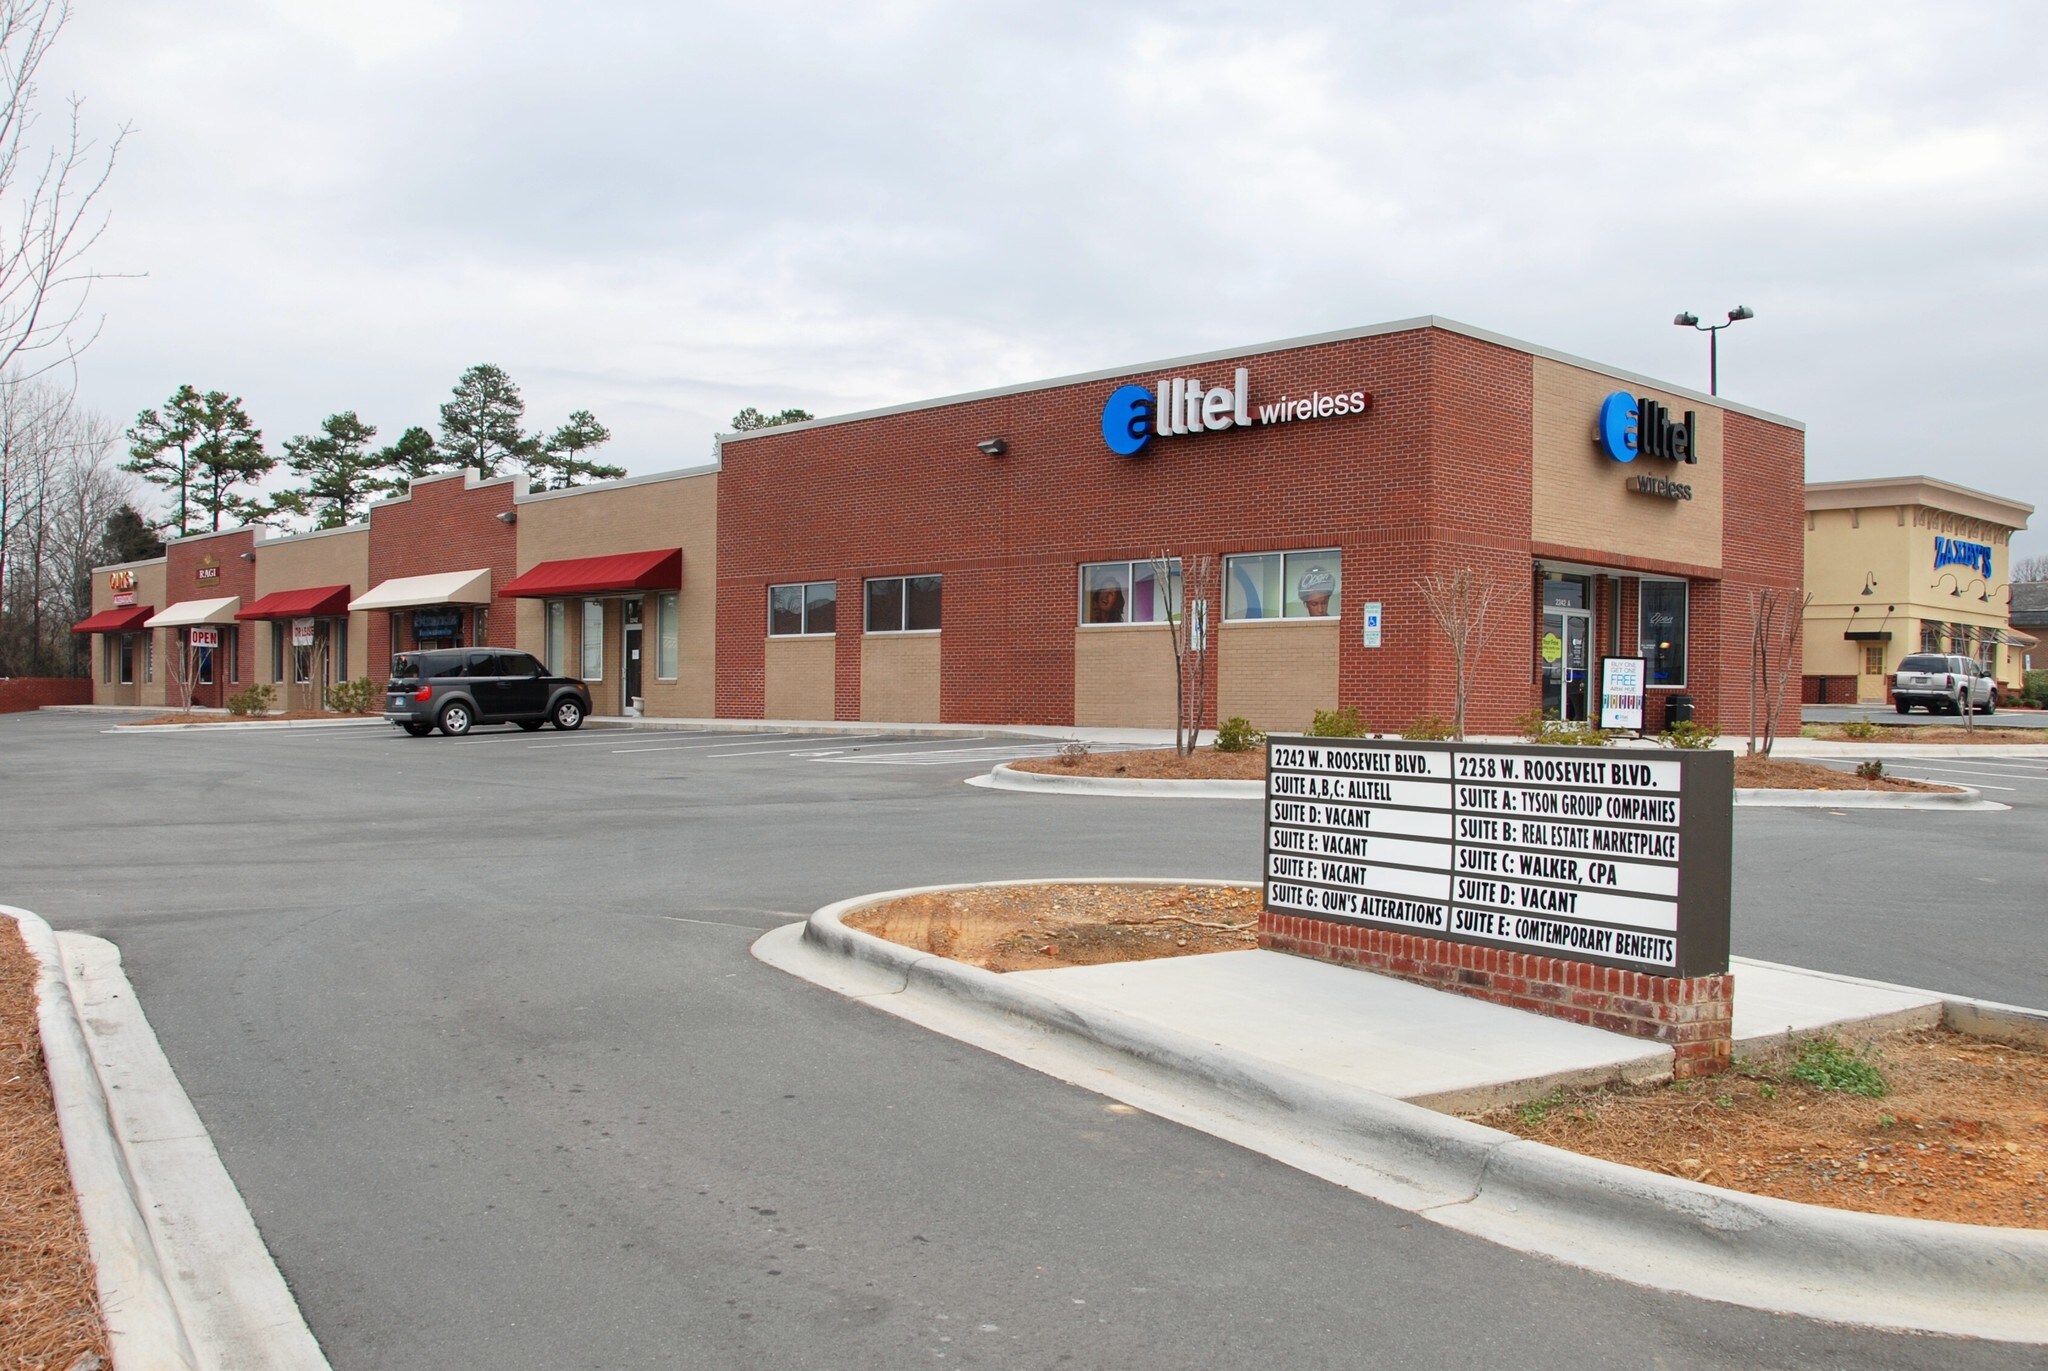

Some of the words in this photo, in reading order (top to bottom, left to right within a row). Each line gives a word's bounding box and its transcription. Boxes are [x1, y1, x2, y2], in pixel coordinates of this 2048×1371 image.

[1102, 367, 1252, 456] alltel
[1259, 391, 1365, 425] wireless
[1599, 391, 1697, 464] alltel
[1636, 471, 1693, 501] wireless
[199, 568, 216, 578] RAGI
[1934, 536, 1992, 579] ZAXBY'S
[192, 631, 217, 643] OPEN
[1611, 674, 1637, 686] FREE
[1275, 748, 1305, 767] 2242
[1308, 750, 1323, 768] W.
[1327, 751, 1391, 772] ROOSEVELT
[1395, 754, 1431, 775] BLVD.
[1459, 756, 1496, 778] 2258
[1500, 759, 1519, 780] W.
[1524, 760, 1606, 784] ROOSEVELT
[1611, 763, 1657, 787] BLVD.
[1275, 775, 1306, 795] SUITE
[1309, 778, 1344, 800] A,B,C:
[1348, 780, 1392, 801] ALLTELL
[1274, 802, 1305, 822] SUITE
[1309, 806, 1321, 824] D:
[1325, 806, 1371, 828] VACANT
[1460, 787, 1498, 809] SUITE
[1502, 791, 1517, 811] A:
[1521, 791, 1558, 814] TYSON
[1562, 794, 1602, 817] GROUP
[1606, 796, 1676, 823] COMPANIES
[1274, 829, 1305, 850] SUITE
[1308, 833, 1318, 851] E:
[1322, 835, 1368, 856] VACANT
[1460, 818, 1498, 841] SUITE
[1502, 822, 1517, 842] B:
[1522, 823, 1548, 846] REAL
[1551, 826, 1589, 849] ESTATE
[1592, 829, 1676, 858] MARKETPLACE
[1273, 857, 1304, 878] SUITE
[1307, 861, 1317, 879] F:
[1321, 862, 1367, 886] VACANT
[1460, 849, 1497, 872] SUITE
[1502, 853, 1514, 873] C:
[1520, 855, 1583, 885] WALKER,
[1588, 862, 1617, 886] CPA
[1272, 884, 1303, 904] SUITE
[1306, 888, 1318, 907] G:
[1322, 891, 1357, 913] QUN'S
[1360, 896, 1442, 926] ALTERATIONS
[1458, 879, 1496, 904] SUITE
[1500, 884, 1516, 906] D:
[1520, 886, 1578, 914] VACANT
[1456, 909, 1493, 934] SUITE
[1498, 915, 1511, 937] E:
[1515, 917, 1612, 953] COMTEMPORARY
[1615, 932, 1673, 962] BENEFITS
